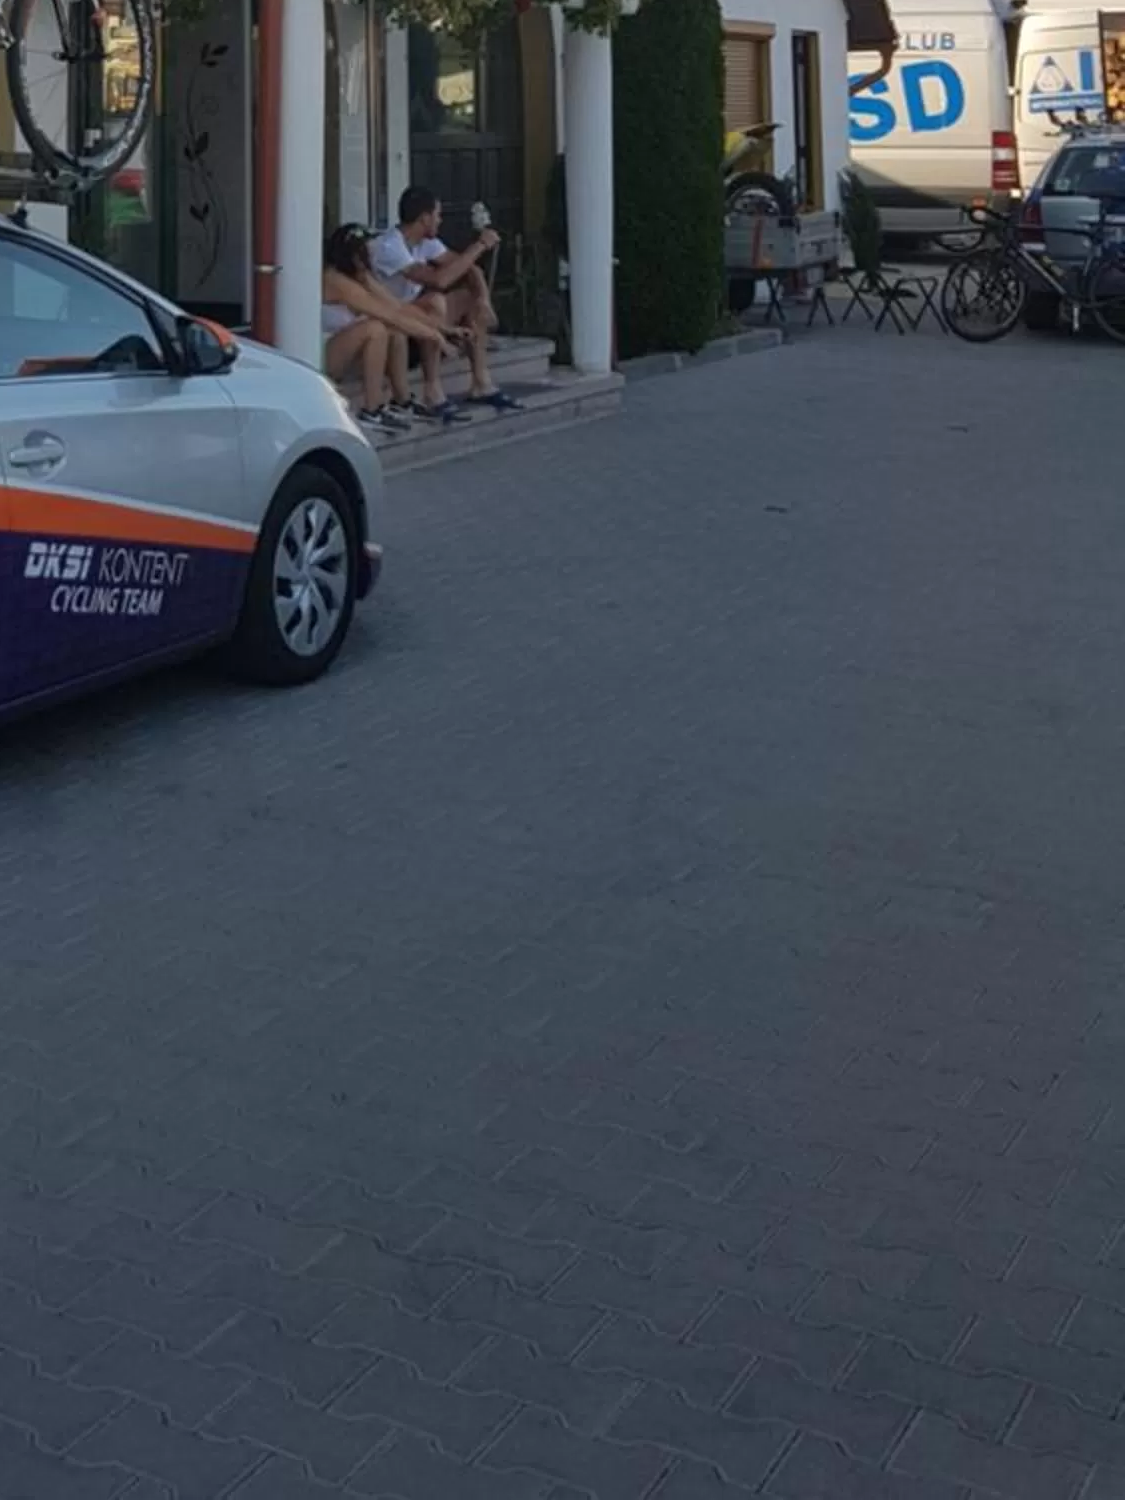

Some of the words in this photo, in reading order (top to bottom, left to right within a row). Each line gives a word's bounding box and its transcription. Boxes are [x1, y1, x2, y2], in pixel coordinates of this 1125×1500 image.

[894, 31, 956, 50] LUB
[98, 548, 191, 585] KONTENT
[50, 584, 120, 615] CYCLING
[121, 588, 165, 616] TEAM
